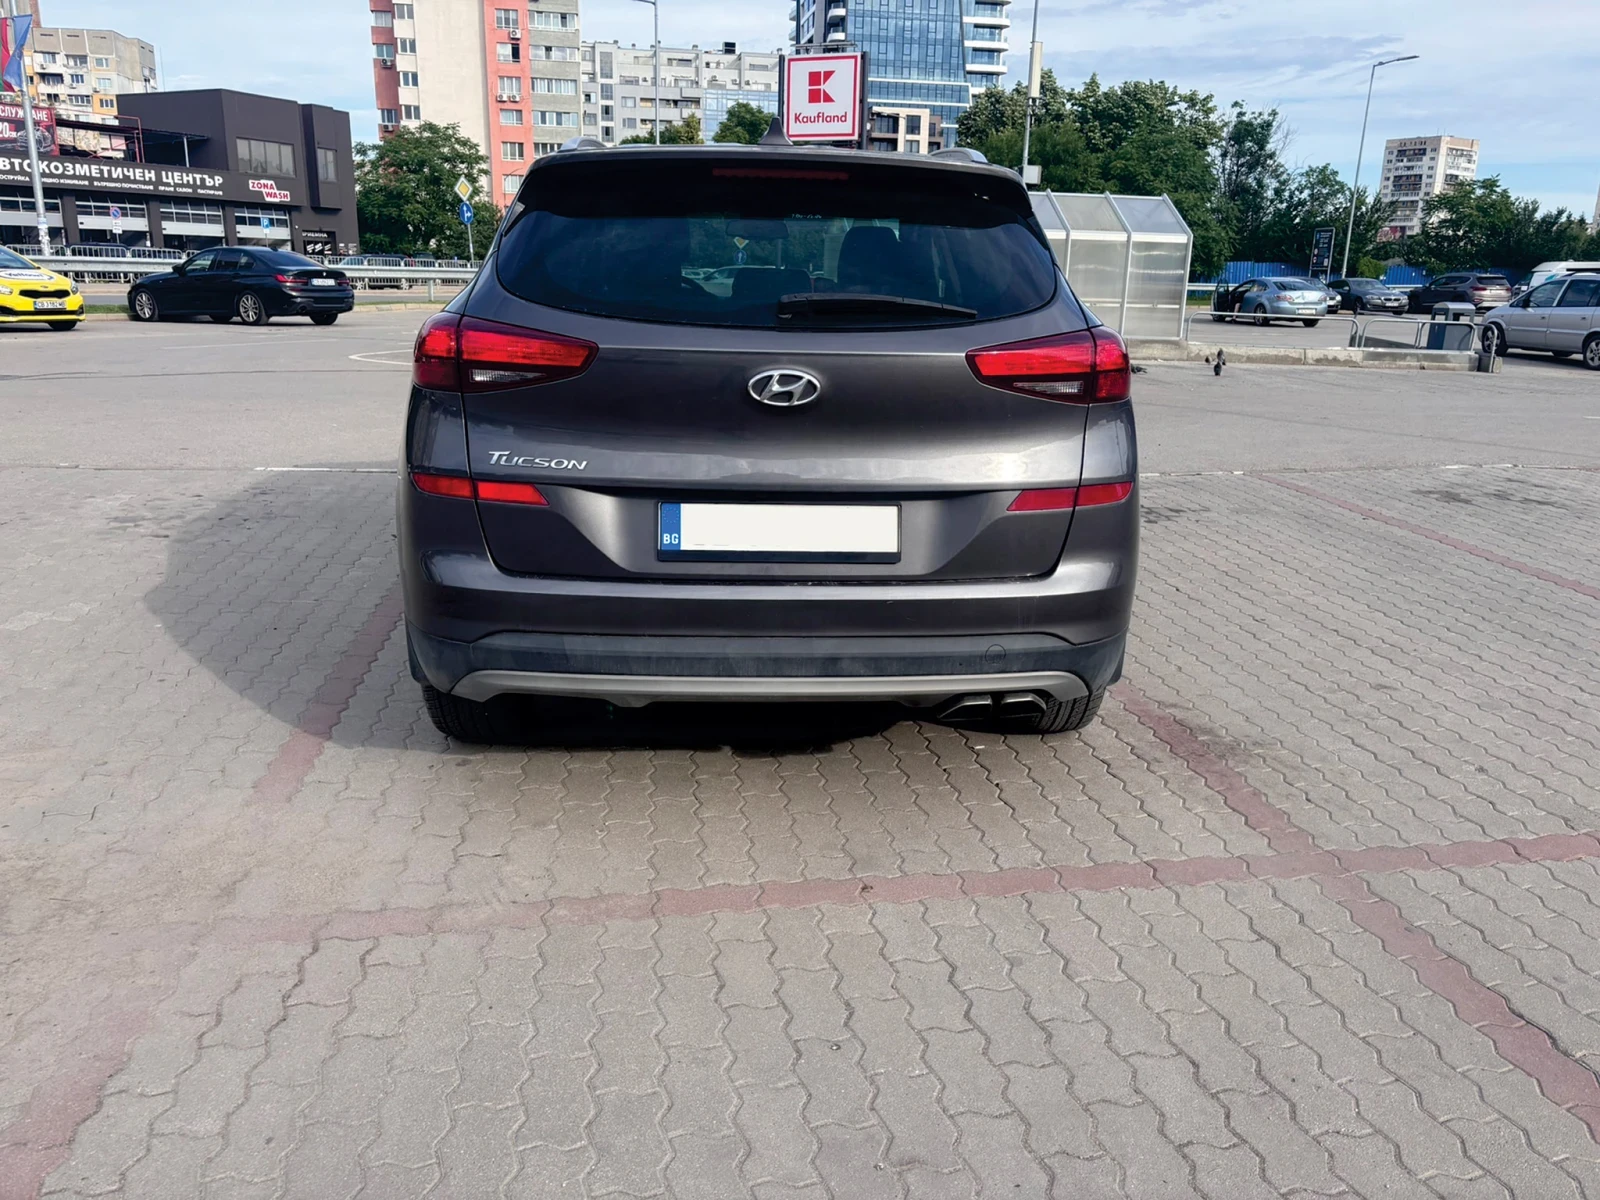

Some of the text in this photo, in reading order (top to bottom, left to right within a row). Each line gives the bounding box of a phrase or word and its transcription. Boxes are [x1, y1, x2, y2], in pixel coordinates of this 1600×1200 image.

[0, 106, 48, 121] СЛУЖАНЕ
[794, 111, 848, 124] Kaufland
[161, 171, 223, 187] ЦЕНТЪР
[250, 181, 275, 190] ZONA
[264, 191, 289, 200] WASH
[663, 533, 679, 544] BG
